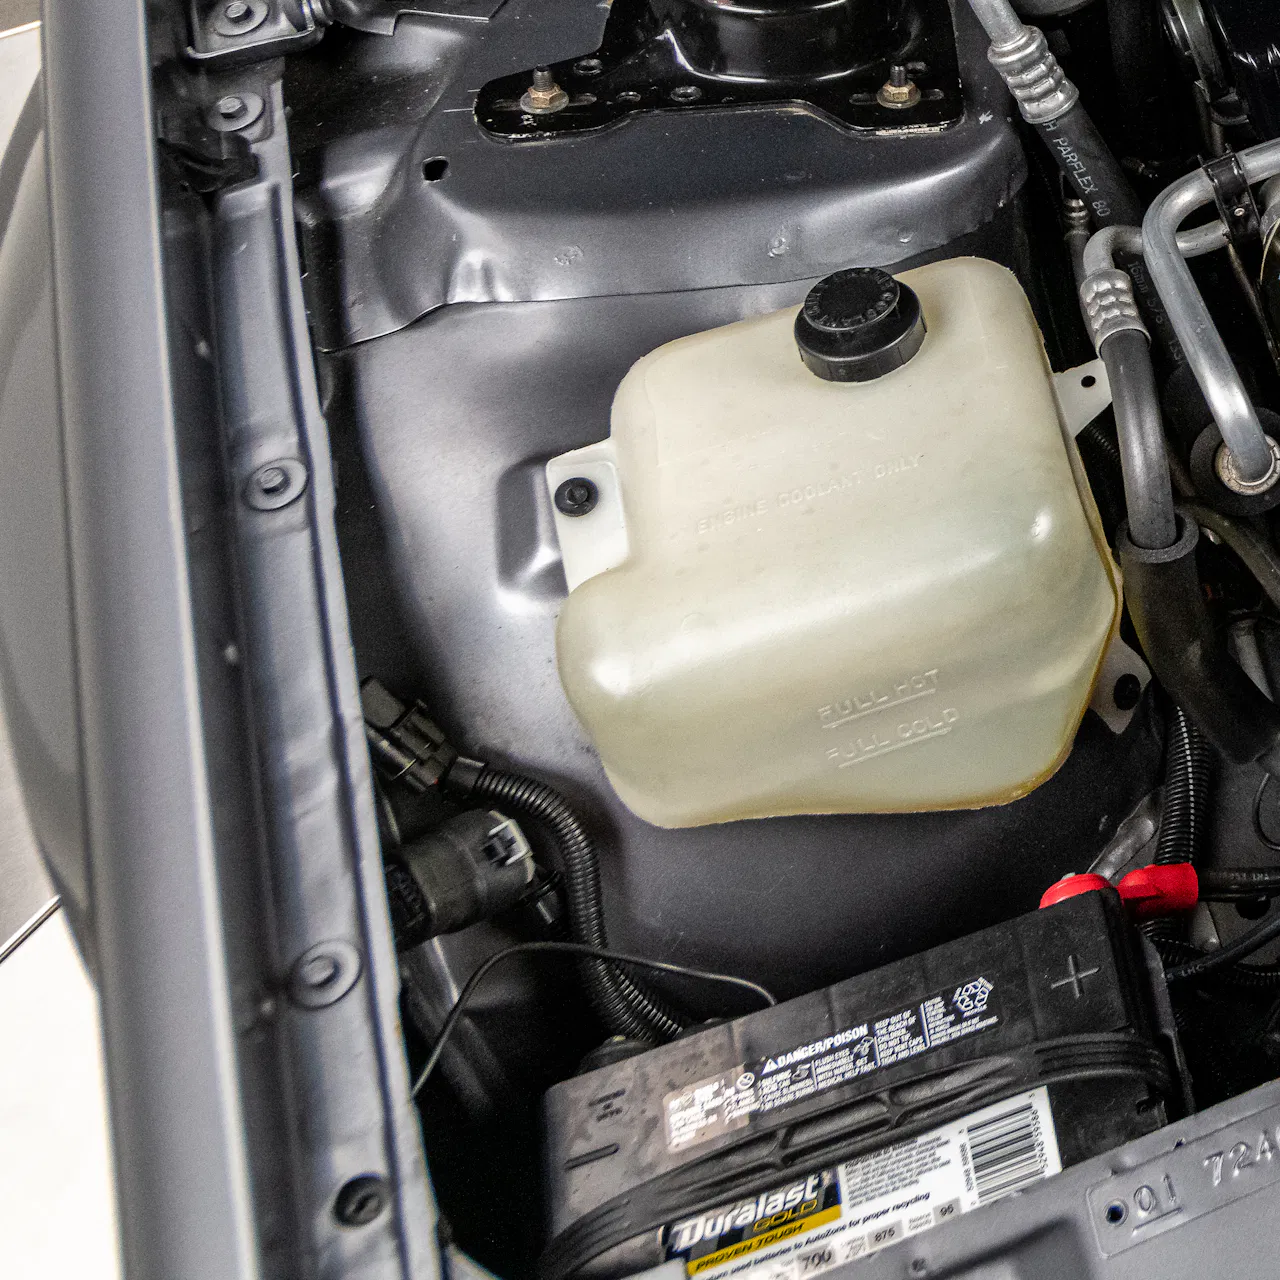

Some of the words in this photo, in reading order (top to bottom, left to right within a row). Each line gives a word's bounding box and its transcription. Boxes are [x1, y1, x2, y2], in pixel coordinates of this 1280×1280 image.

[1053, 136, 1099, 195] PARFLEX
[1091, 199, 1111, 218] 80
[697, 499, 769, 535] ENGINE
[777, 470, 867, 507] COOLANT
[874, 452, 922, 480] ONLY
[818, 691, 891, 721] FULL
[892, 668, 940, 698] HOT
[895, 707, 961, 740] COLD
[776, 1023, 869, 1070] DANGER/POISON
[875, 1017, 890, 1029] KEEP
[670, 1173, 821, 1254] Duralast
[753, 1199, 818, 1233] GOLD
[753, 1244, 793, 1266] batteries
[804, 1223, 848, 1247] AutoZone
[848, 1216, 861, 1231] for
[862, 1207, 891, 1228] proper
[892, 1190, 931, 1216] recycling
[873, 1226, 897, 1243] 875
[695, 1242, 754, 1272] PROVEN
[755, 1221, 806, 1248] TOUGH
[801, 1249, 833, 1271] 700
